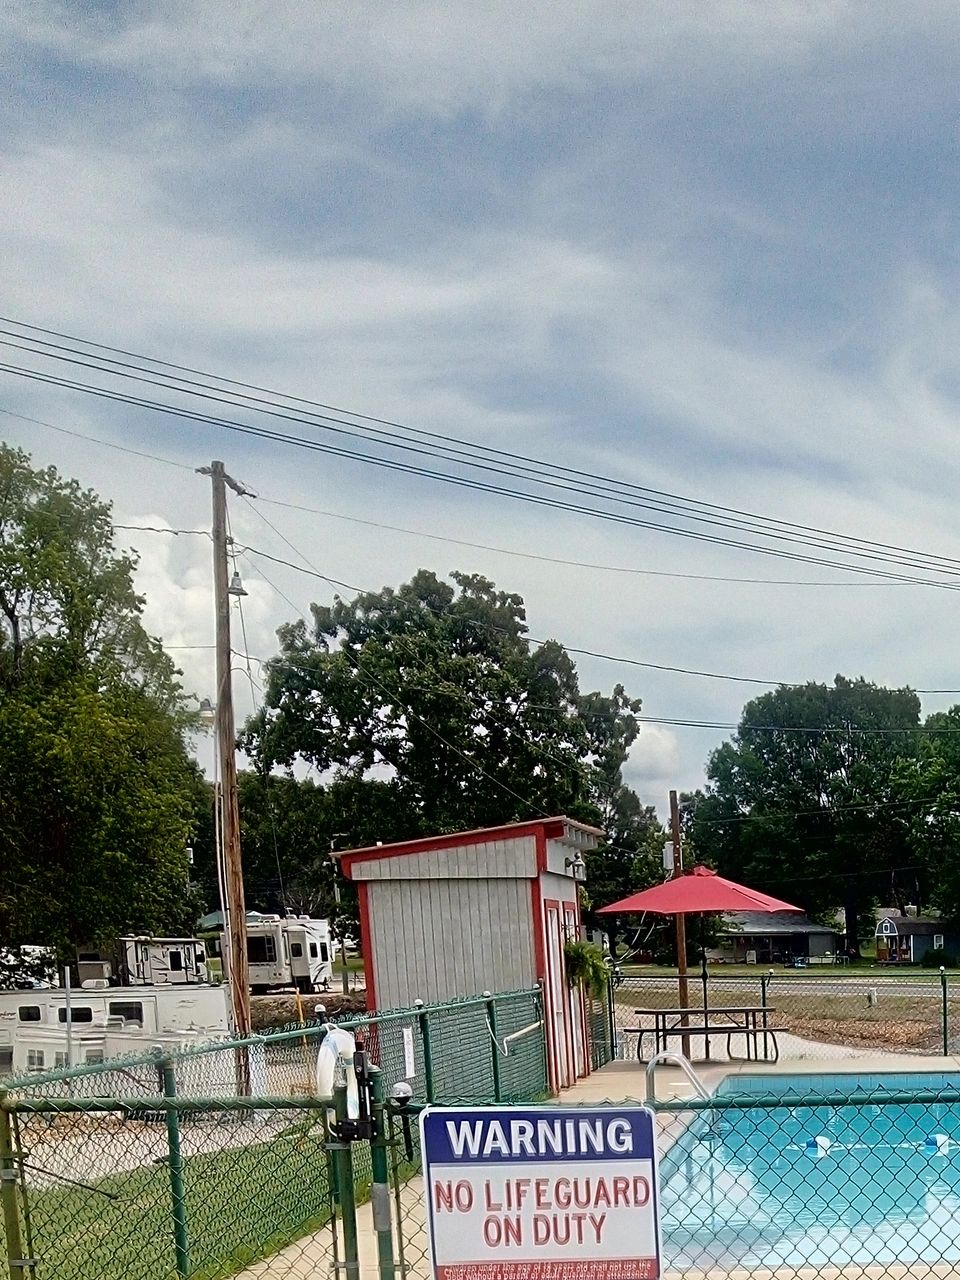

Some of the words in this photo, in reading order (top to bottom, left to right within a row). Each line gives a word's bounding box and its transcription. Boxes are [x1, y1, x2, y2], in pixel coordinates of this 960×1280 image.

[446, 1117, 634, 1158] WARNING
[434, 1179, 474, 1213] NO
[484, 1175, 650, 1212] LIFEGUARD
[483, 1213, 522, 1247] ON
[532, 1211, 606, 1246] DUTY
[478, 1263, 501, 1275] under
[590, 1260, 608, 1272] shall
